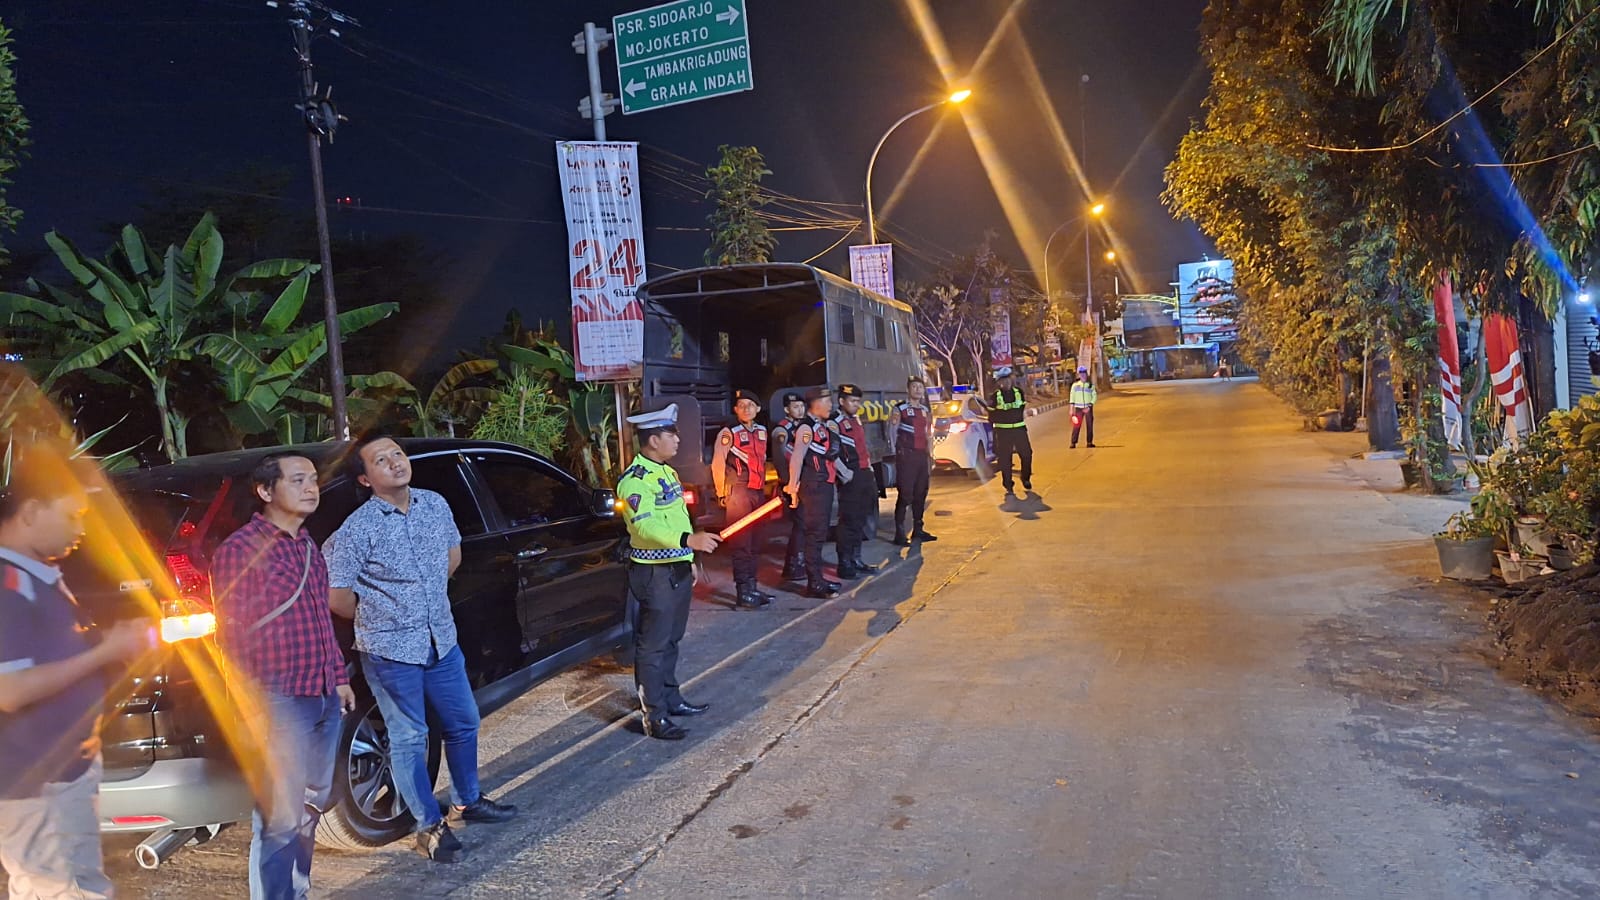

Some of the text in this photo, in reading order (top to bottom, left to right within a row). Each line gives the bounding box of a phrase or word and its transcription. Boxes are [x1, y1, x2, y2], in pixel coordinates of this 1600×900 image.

[617, 1, 713, 36] PSR. SIDOARJO
[625, 26, 709, 58] MOJOKERTO
[643, 45, 746, 80] TAMBAKRIGADUNG
[650, 69, 747, 102] GRAHA INDAH
[572, 238, 643, 290] 24
